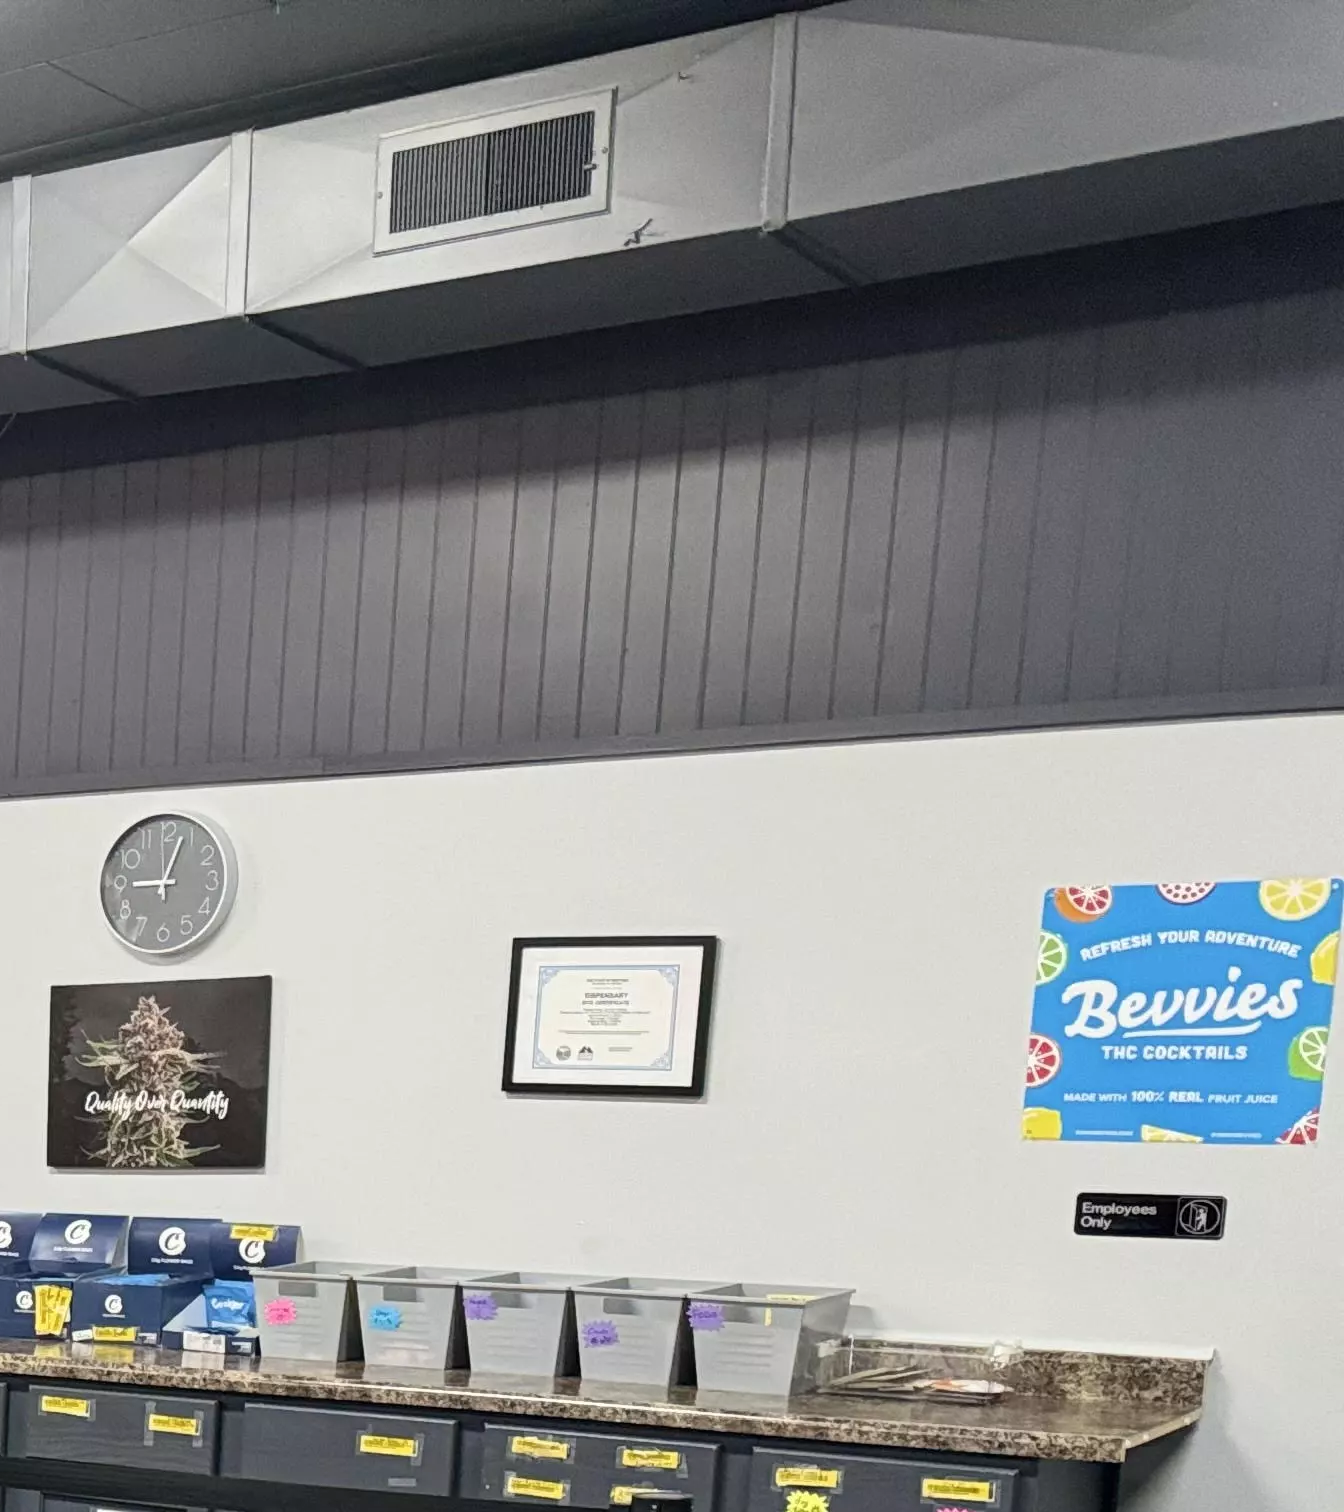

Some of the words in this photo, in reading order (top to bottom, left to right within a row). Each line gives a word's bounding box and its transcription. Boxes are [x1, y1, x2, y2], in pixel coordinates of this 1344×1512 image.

[140, 828, 152, 849] 11
[160, 821, 177, 842] 12
[120, 848, 141, 869] 10
[200, 845, 215, 866] 2
[114, 875, 127, 893] 9
[205, 870, 219, 891] 3
[120, 899, 131, 920] 8
[198, 896, 211, 915] 4
[136, 916, 148, 936] 7
[157, 922, 170, 943] 6
[180, 915, 193, 935] 5
[1080, 932, 1152, 961] REFRESH
[1157, 930, 1200, 944] YOUR
[1204, 930, 1303, 959] ADVENTURE
[1061, 965, 1303, 1039] Bevvies
[1101, 1046, 1138, 1060] THC
[1143, 1046, 1248, 1061] COCKTAILS
[85, 1090, 133, 1121] Quality
[135, 1090, 169, 1112] Over
[170, 1089, 230, 1120] Quantity
[1063, 1092, 1096, 1102] MADE
[1098, 1093, 1128, 1102] WITH
[1131, 1090, 1165, 1103] 100%
[1168, 1091, 1204, 1103] REAL
[1207, 1093, 1241, 1104] FRUIT
[1244, 1094, 1278, 1104] JUICE
[1082, 1202, 1157, 1217] Employees
[1080, 1215, 1112, 1230] Only
